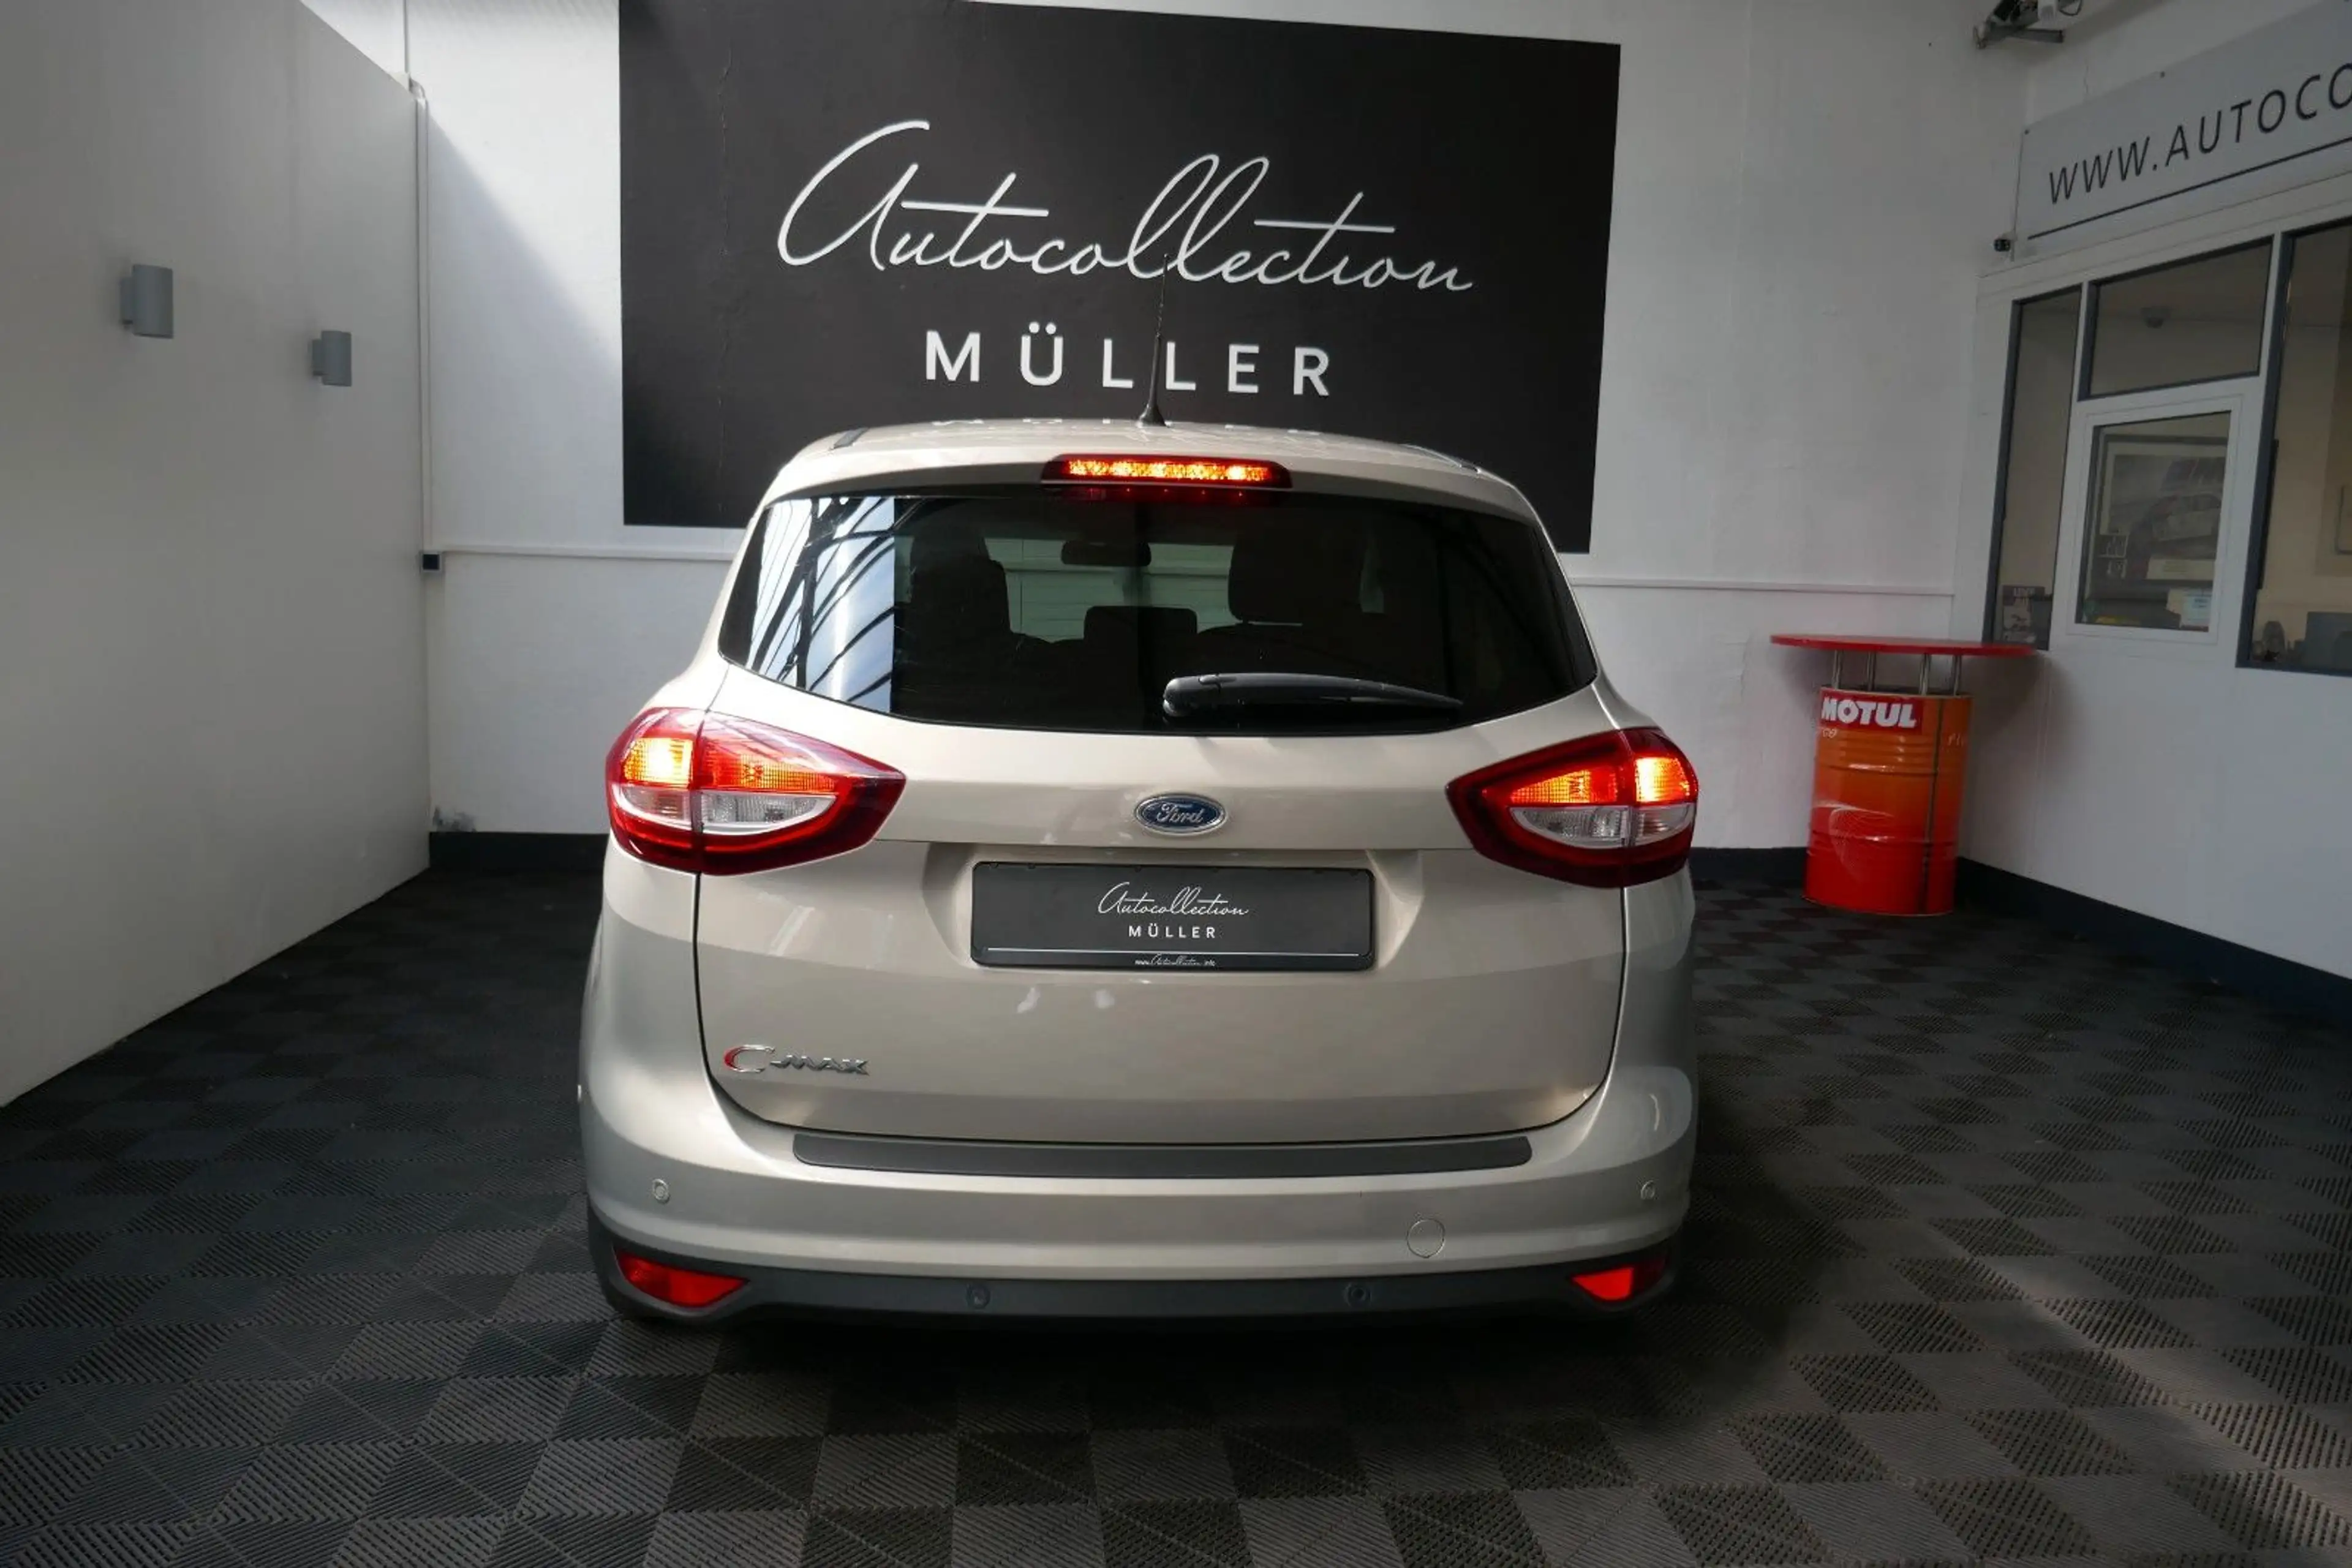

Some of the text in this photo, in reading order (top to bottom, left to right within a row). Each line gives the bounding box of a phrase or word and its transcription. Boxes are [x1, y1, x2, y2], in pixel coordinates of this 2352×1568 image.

[777, 120, 1474, 292] Autocollection
[925, 322, 1330, 397] MÜLLER
[1821, 697, 1917, 728] MOTUL
[1156, 804, 1205, 823] Ford
[1098, 881, 1250, 915] Autocollection
[1128, 923, 1216, 938] MÜLLER
